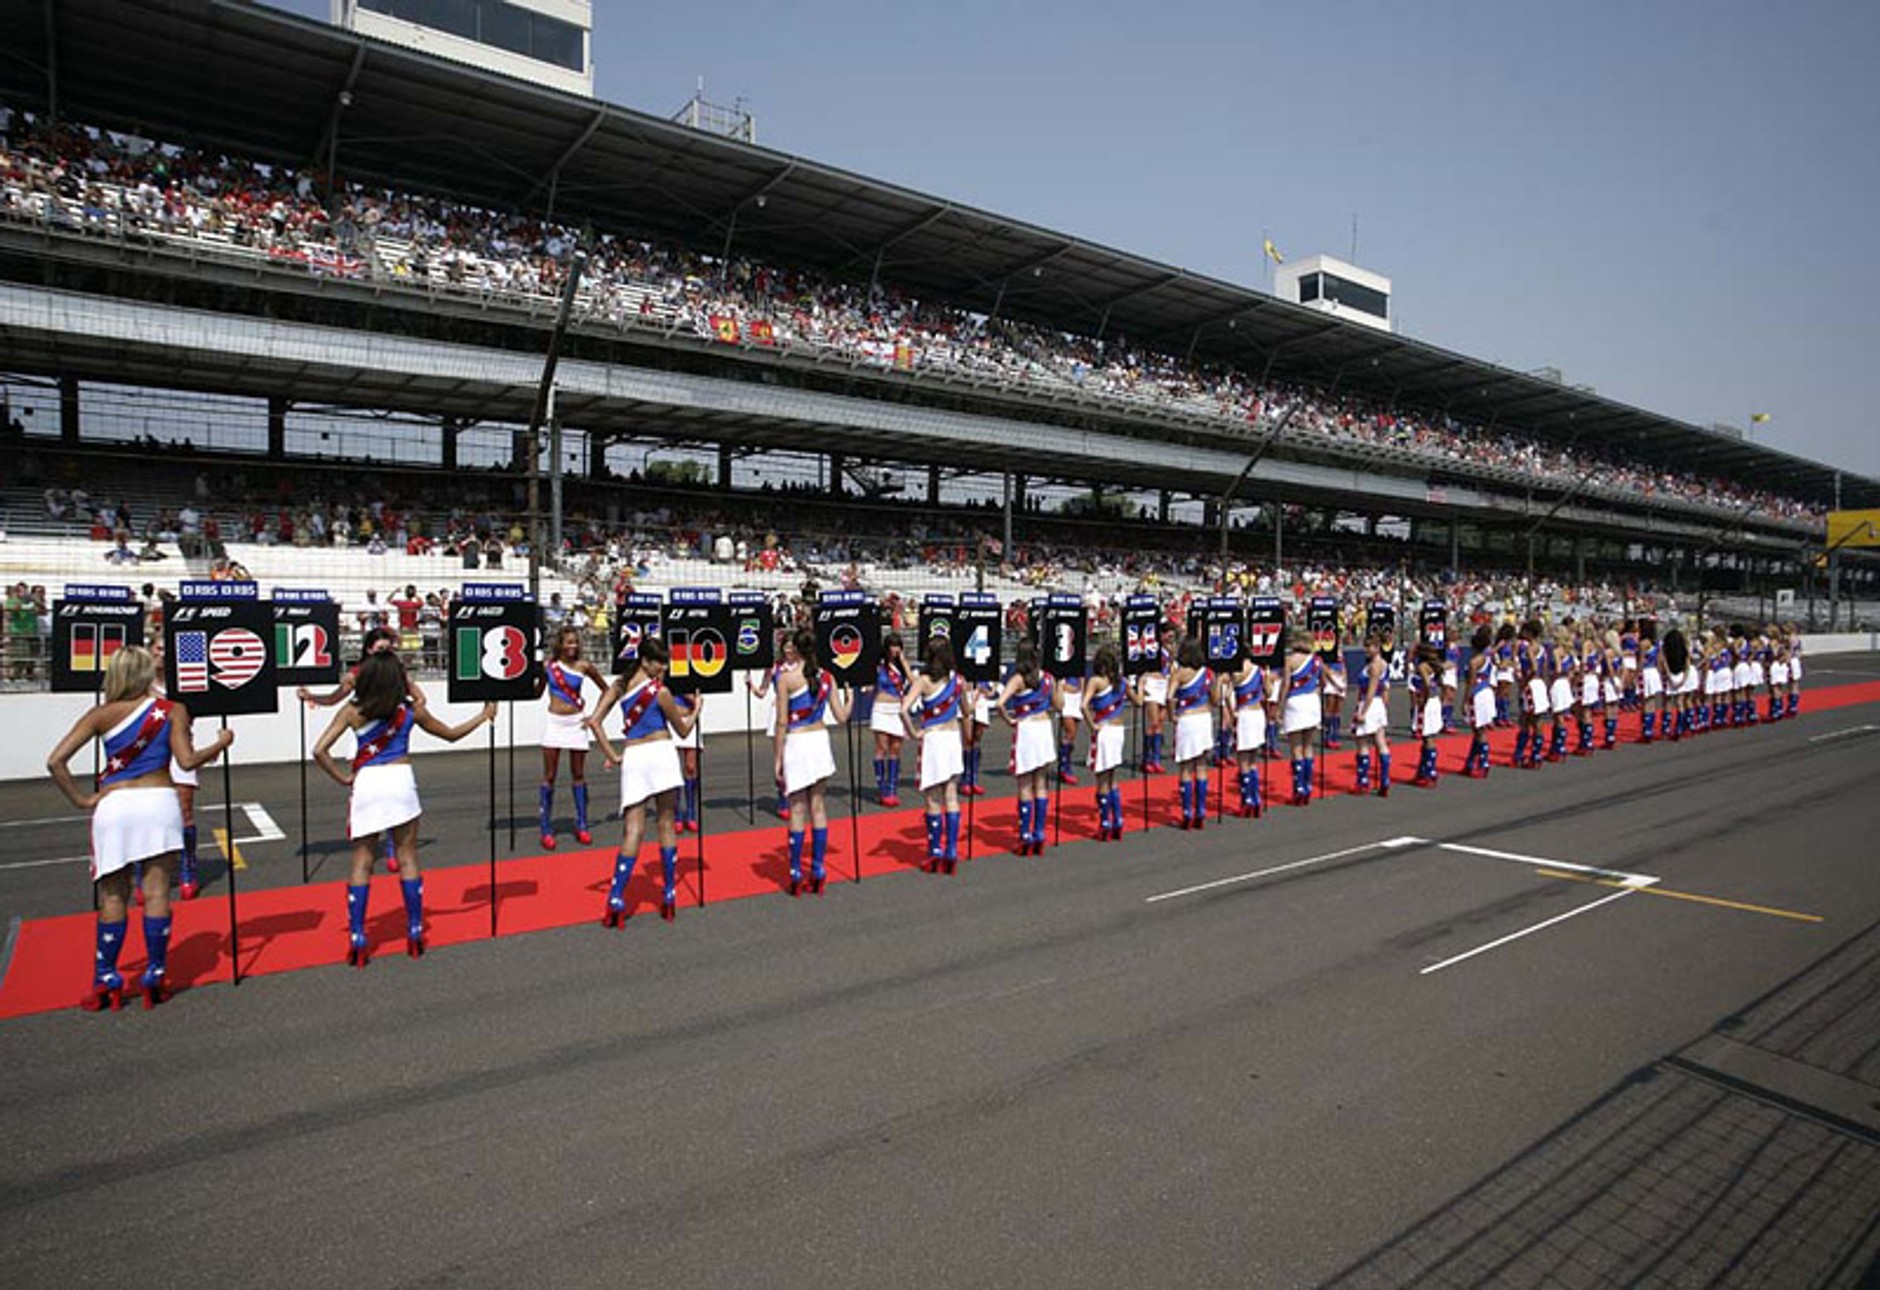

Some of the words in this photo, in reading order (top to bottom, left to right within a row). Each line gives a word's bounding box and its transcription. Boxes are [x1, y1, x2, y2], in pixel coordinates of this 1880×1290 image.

[194, 585, 218, 596] RBS
[233, 585, 256, 596] RBS
[474, 587, 493, 598] RBS
[504, 587, 523, 598] RBS
[199, 606, 232, 618] SPEED
[274, 622, 332, 668] 12
[456, 625, 528, 680] 18
[668, 627, 727, 677] 10
[736, 618, 760, 655] 5
[829, 623, 863, 669] 9
[963, 624, 992, 665] 4
[1054, 622, 1075, 662] 3
[1127, 623, 1159, 661] 14
[1251, 623, 1282, 656] 17
[174, 627, 267, 693] 19
